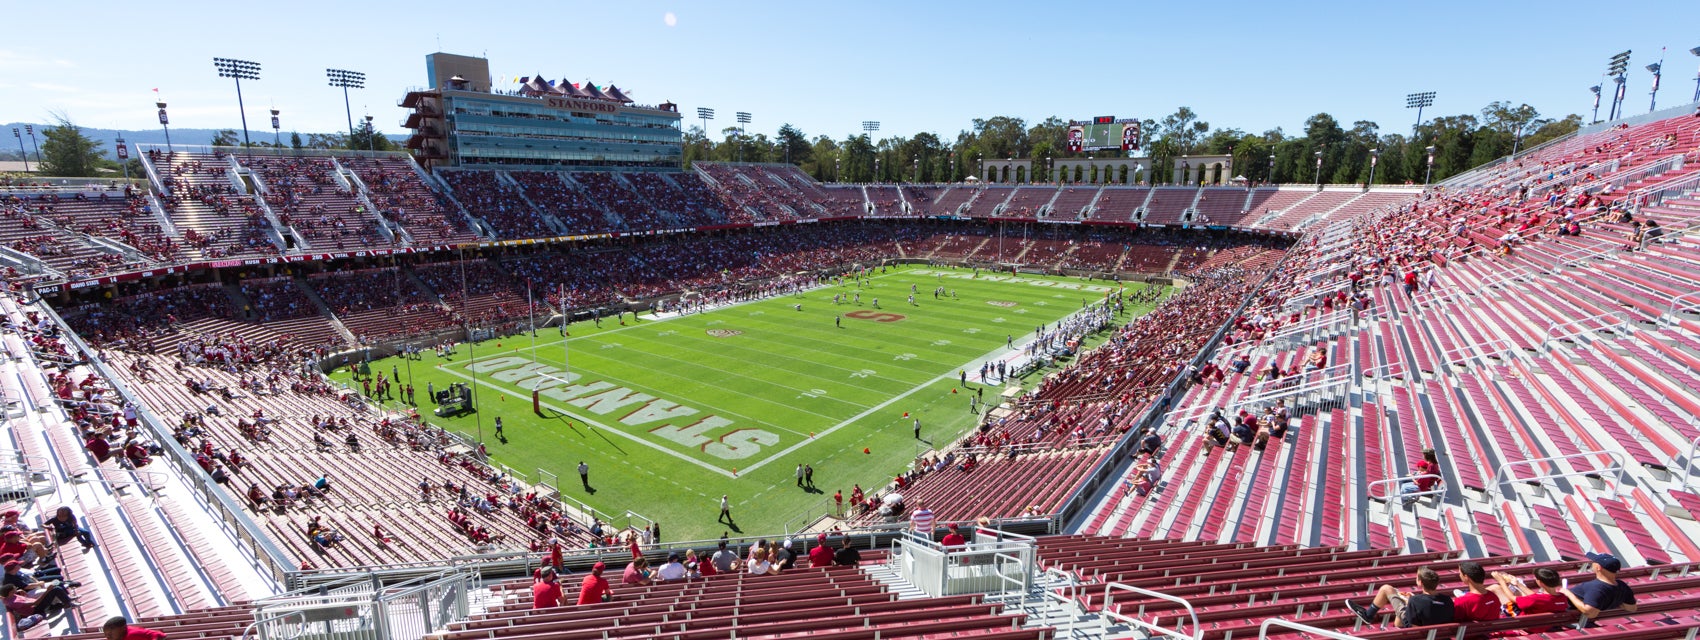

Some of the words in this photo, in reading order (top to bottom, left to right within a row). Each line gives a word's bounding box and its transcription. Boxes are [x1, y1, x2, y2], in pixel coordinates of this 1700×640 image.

[548, 98, 616, 113] STANFORD
[118, 147, 126, 156] S
[70, 281, 86, 289] IDAHO
[85, 279, 100, 287] STATE
[907, 269, 1114, 293] STANFORD
[38, 286, 59, 294] PAC-12
[844, 309, 906, 323] S
[850, 369, 876, 379] 20
[800, 388, 827, 399] 10
[463, 356, 780, 461] STANFORD
